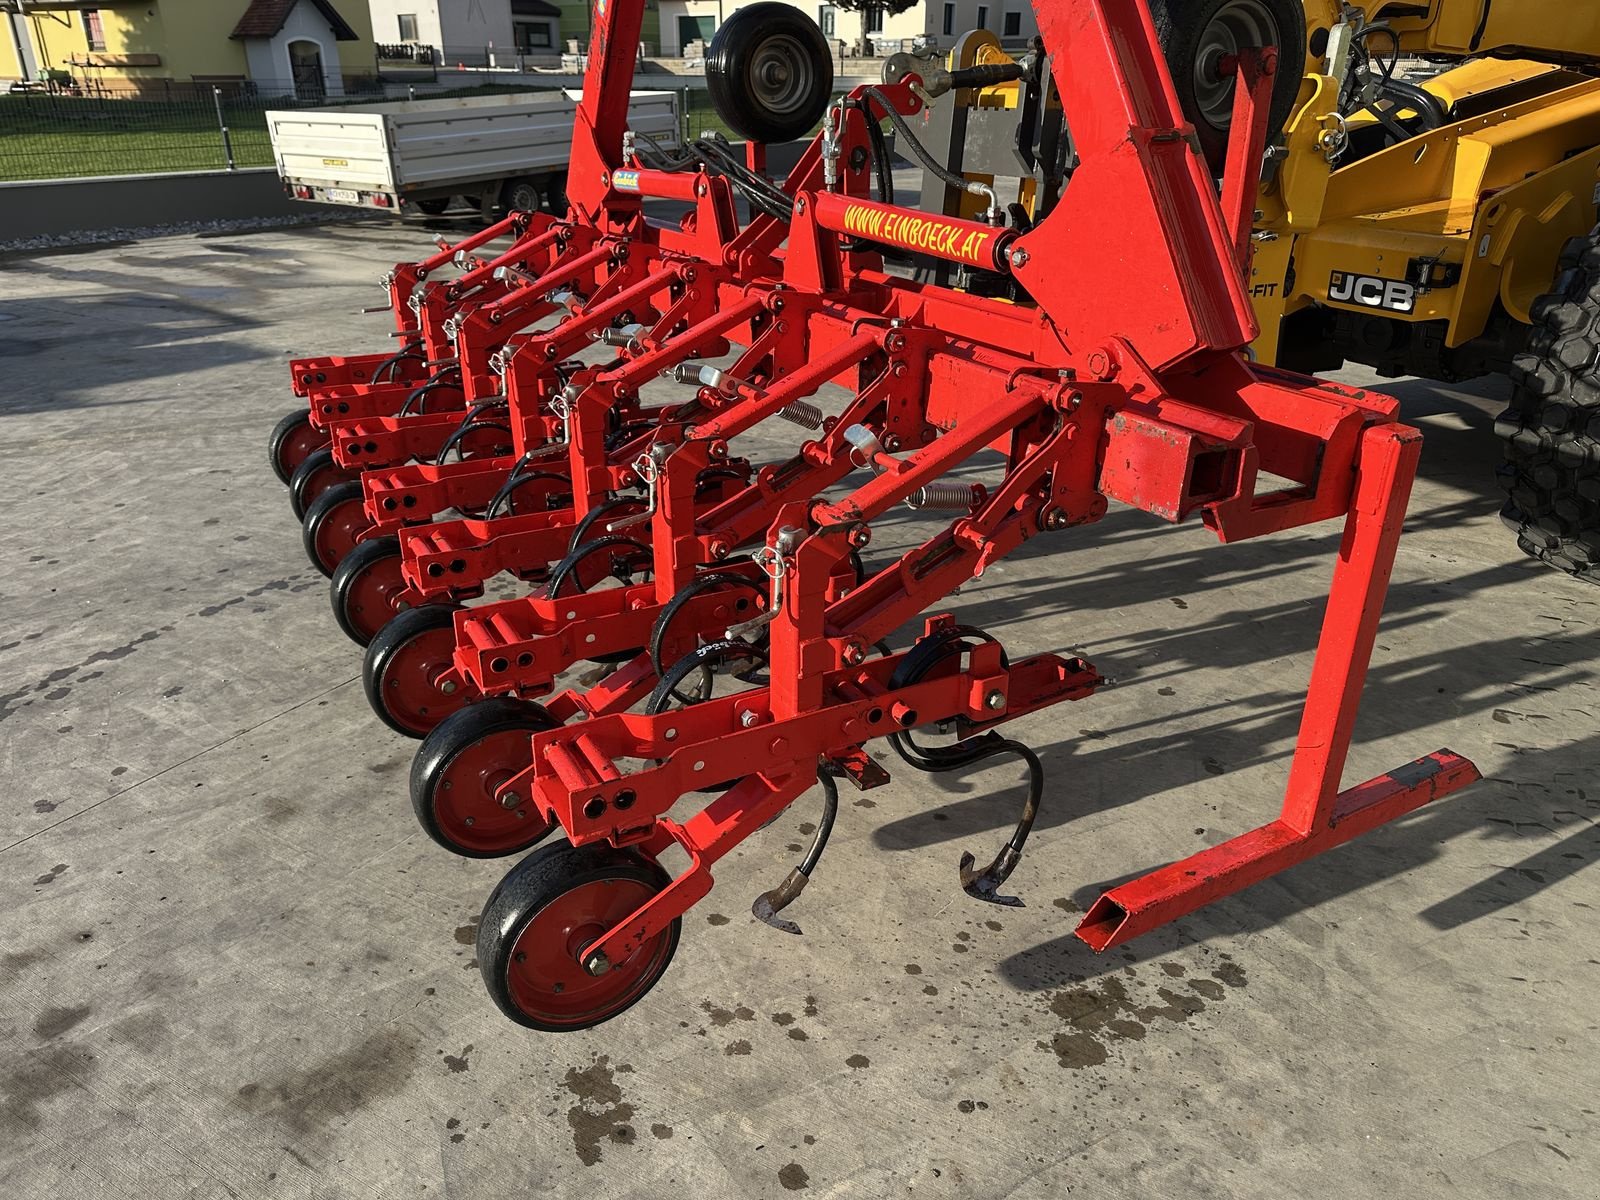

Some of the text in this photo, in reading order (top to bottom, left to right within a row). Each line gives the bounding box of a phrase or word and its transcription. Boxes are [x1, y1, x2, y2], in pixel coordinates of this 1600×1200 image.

[844, 204, 990, 261] WWW.EINBOECK.AT
[1248, 283, 1278, 298] -FIT
[1330, 275, 1414, 311] JCB
